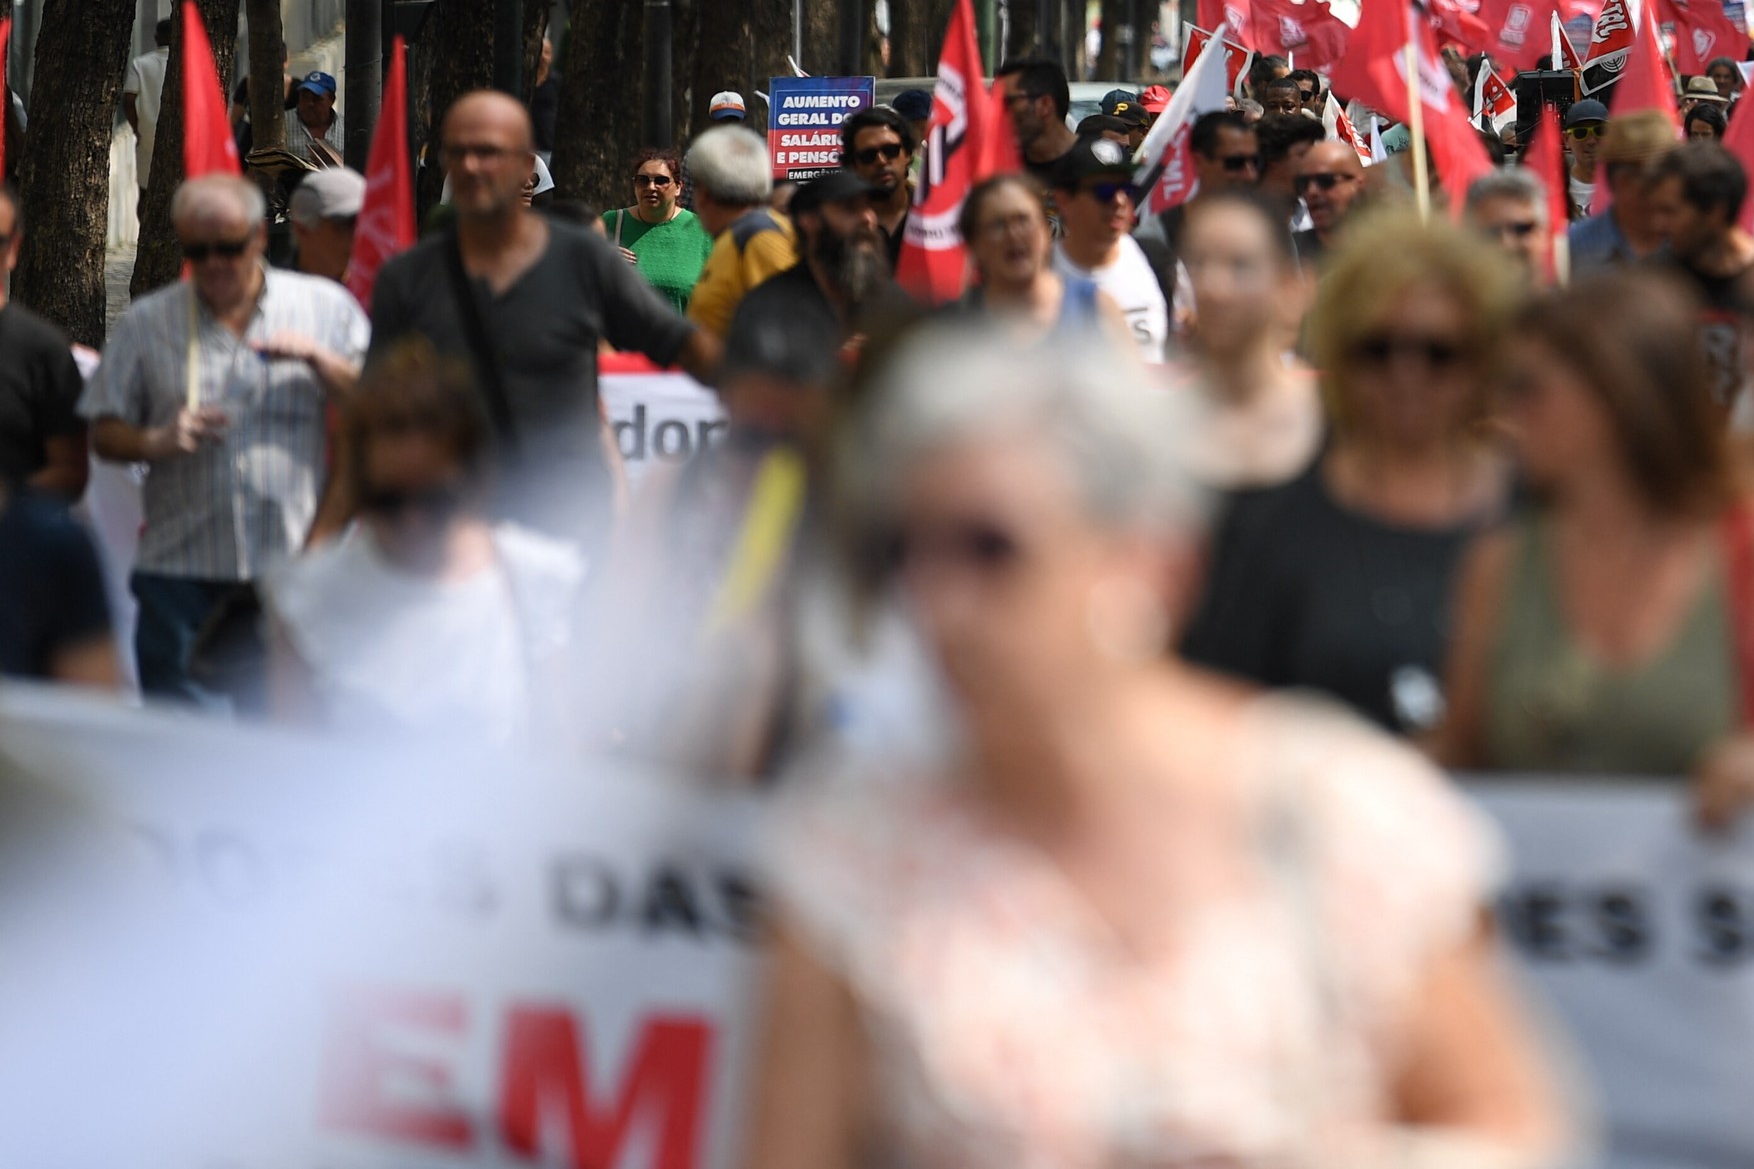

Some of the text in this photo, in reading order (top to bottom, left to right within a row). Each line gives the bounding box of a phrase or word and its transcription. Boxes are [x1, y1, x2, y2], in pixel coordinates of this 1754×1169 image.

[782, 95, 861, 109] AUMENTO
[778, 112, 829, 126] GERAL
[776, 148, 841, 164] E PENSÕ
